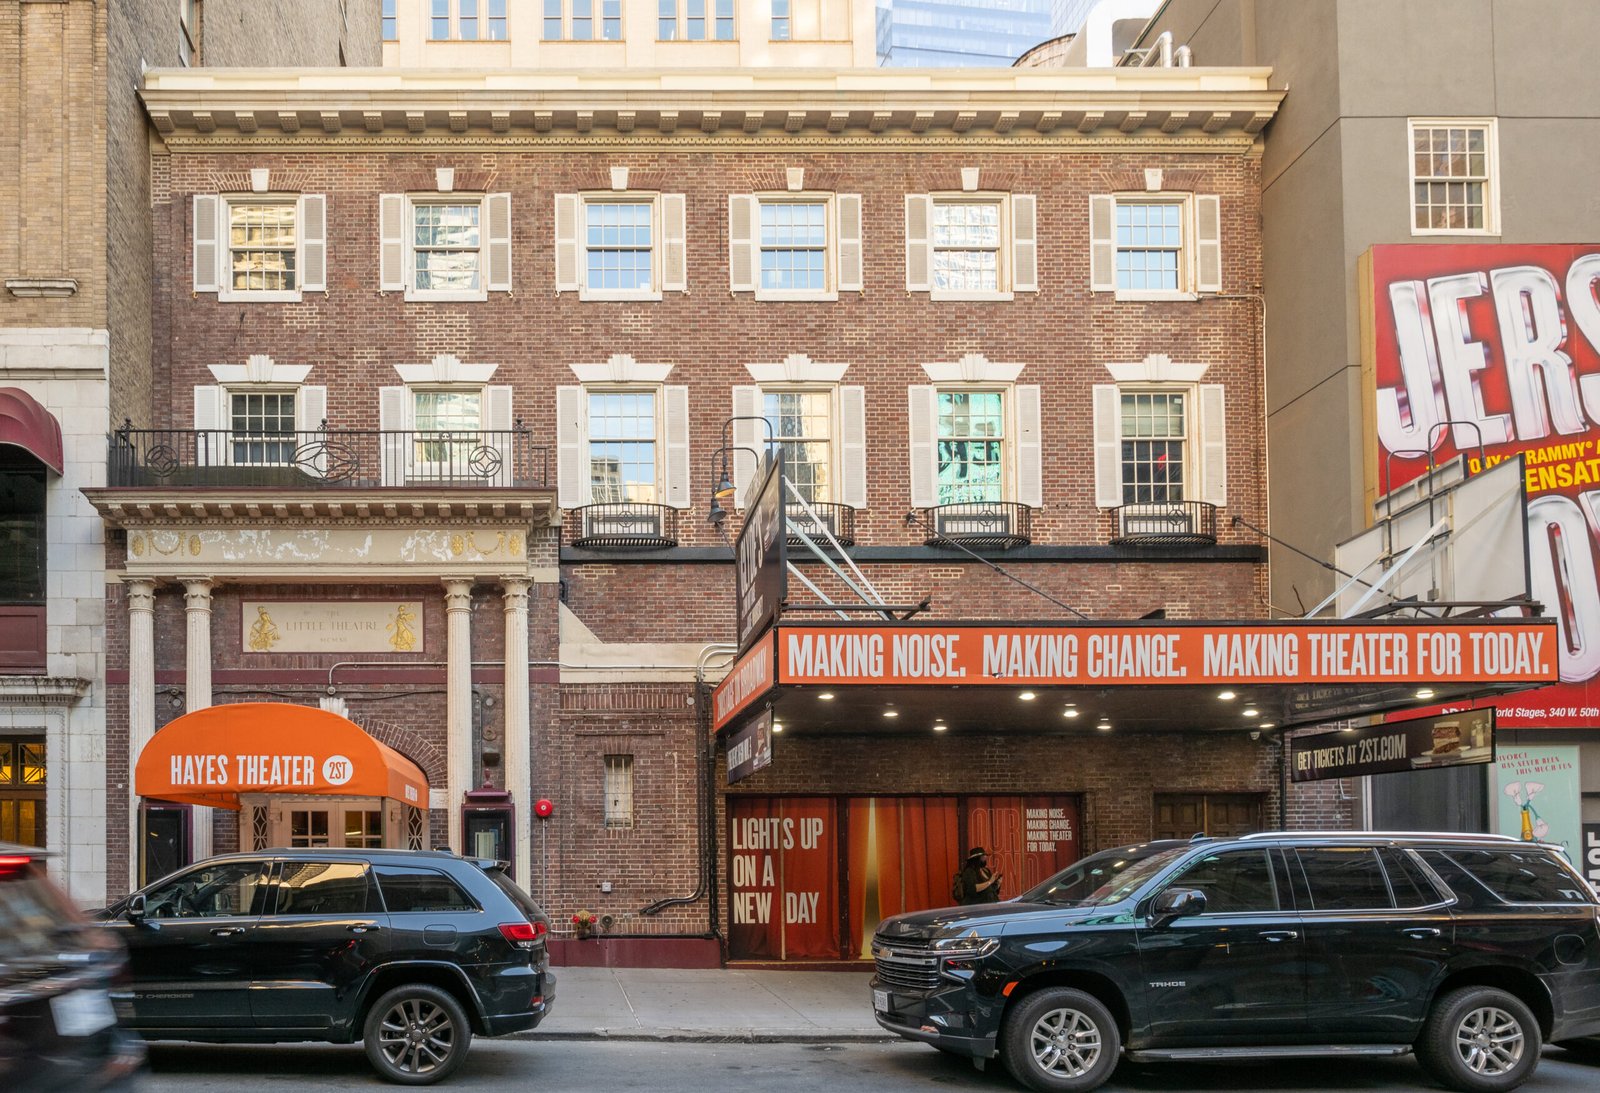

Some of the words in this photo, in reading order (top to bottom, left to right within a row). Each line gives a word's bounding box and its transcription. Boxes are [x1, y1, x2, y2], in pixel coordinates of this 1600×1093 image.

[1468, 454, 1501, 474] ONY
[1516, 441, 1593, 466] RAMMY®
[286, 621, 325, 631] LITTLE
[330, 621, 379, 631] THEATRE
[788, 634, 884, 677] MAKING
[892, 633, 966, 677] NOISE.
[983, 634, 1079, 678] MAKING
[1087, 634, 1187, 678] CHANGE.
[1203, 633, 1299, 677] MAKING
[1307, 633, 1409, 676] THEATER
[1416, 632, 1461, 675] FOR
[1469, 632, 1549, 675] TODAY.
[1495, 707, 1514, 717] orld
[1515, 707, 1547, 719] Stages,
[1549, 707, 1566, 717] 340
[1567, 707, 1578, 717] W.
[1579, 707, 1600, 717] 50th
[1297, 750, 1312, 770] GET
[1313, 746, 1345, 769] TICKETS
[1346, 744, 1357, 765] AT
[1359, 733, 1407, 764] 2ST.COM
[170, 754, 229, 785] HAYES
[236, 755, 315, 785] THEATER
[329, 761, 347, 780] 2ST
[1026, 808, 1048, 819] MAKING
[1048, 808, 1066, 819] NOISE.
[1026, 820, 1048, 830] MAKING
[1049, 819, 1072, 830] CHANGE.
[732, 817, 795, 850] LIGHTS
[800, 817, 824, 849] UP
[972, 807, 1022, 853] OUR
[1026, 831, 1049, 841] MAKING
[1049, 830, 1072, 841] THEATER
[1027, 842, 1038, 852] FOR
[1039, 842, 1057, 852] TODAY.
[733, 855, 757, 887] ON
[762, 855, 775, 887] A
[733, 892, 772, 924] NEW
[785, 892, 820, 924] DAY
